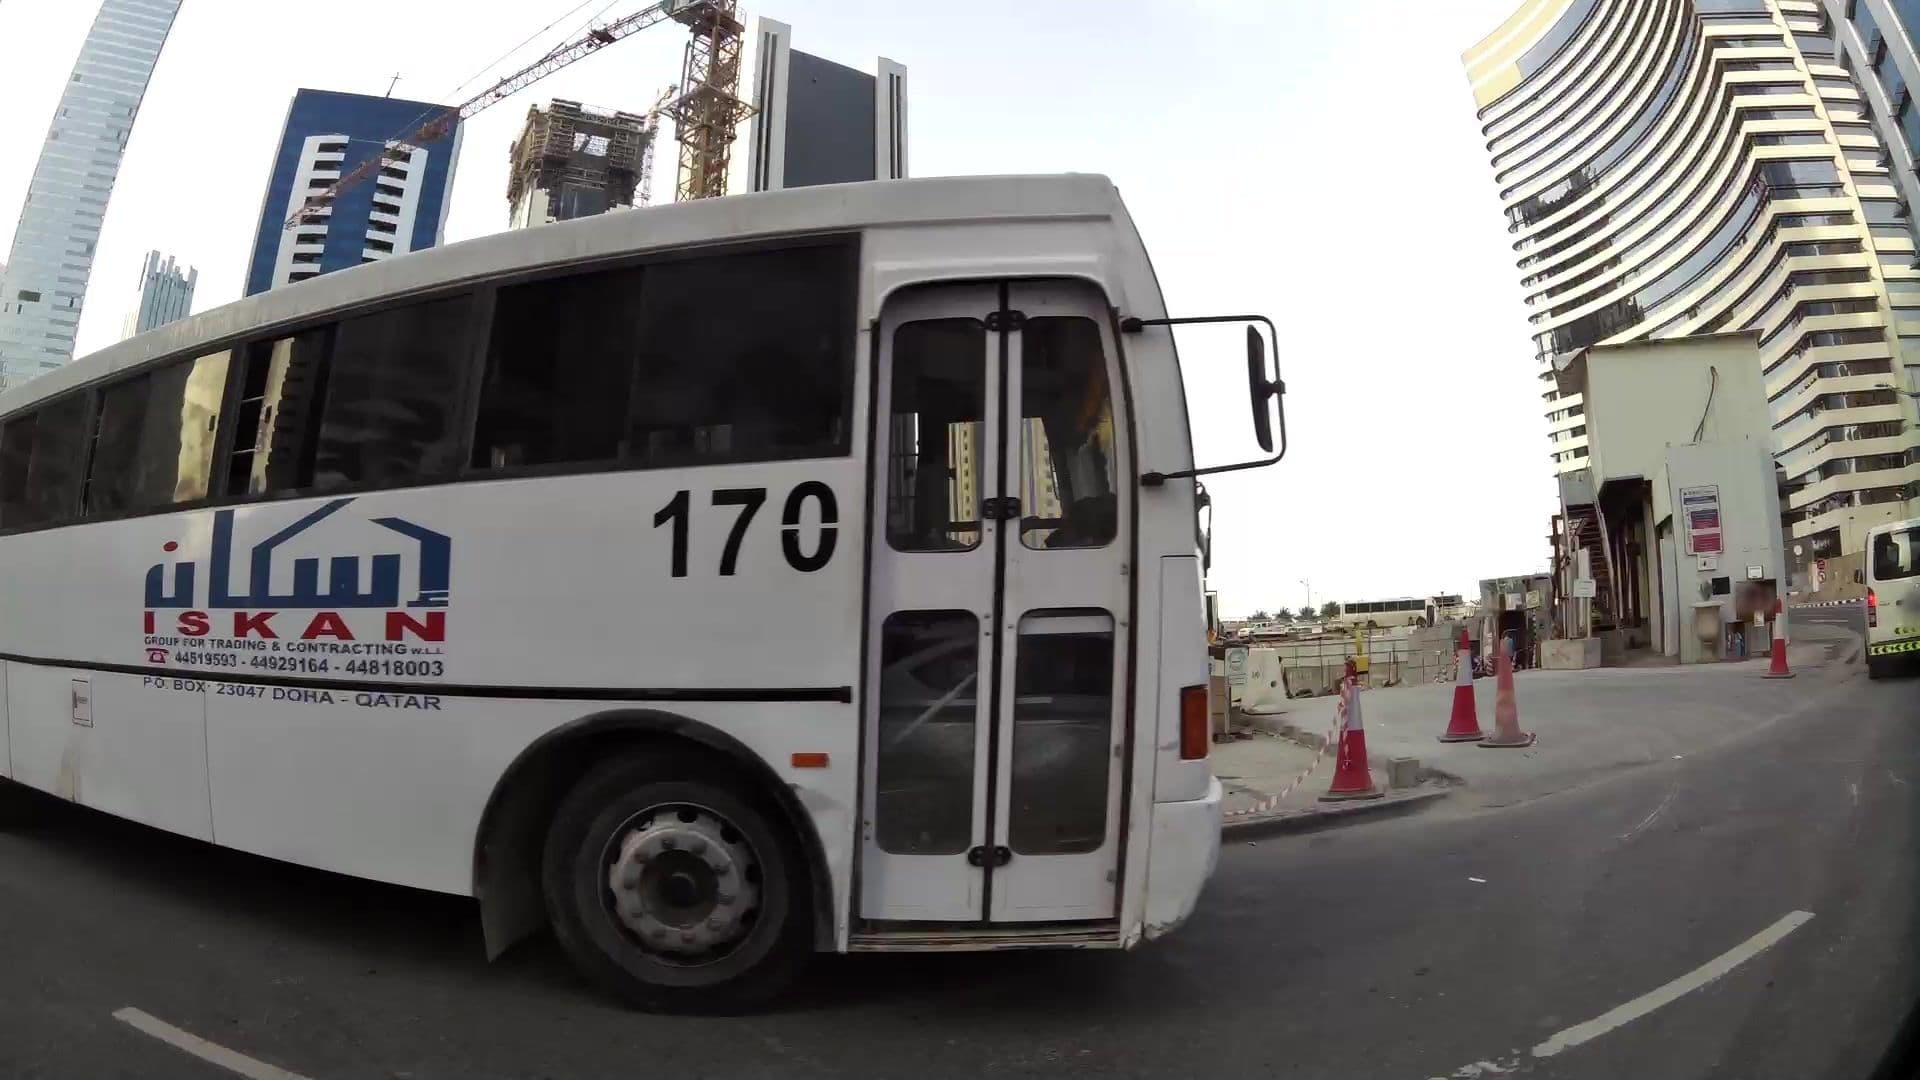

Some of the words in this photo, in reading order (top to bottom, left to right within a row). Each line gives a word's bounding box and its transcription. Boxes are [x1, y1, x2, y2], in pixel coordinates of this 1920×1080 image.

[653, 480, 839, 578] 170
[144, 611, 446, 642] ISKAN
[144, 636, 179, 647] GROUP
[183, 637, 205, 649] FOR
[210, 639, 266, 652] TRADING
[271, 641, 281, 652] &
[286, 642, 408, 656] CONTRACTING
[175, 651, 237, 668] 44519593
[250, 655, 329, 673] 44929164
[345, 659, 444, 677] 44818003
[216, 683, 266, 699] 23047
[272, 687, 335, 705] DOHA
[355, 693, 442, 711] QATAR
